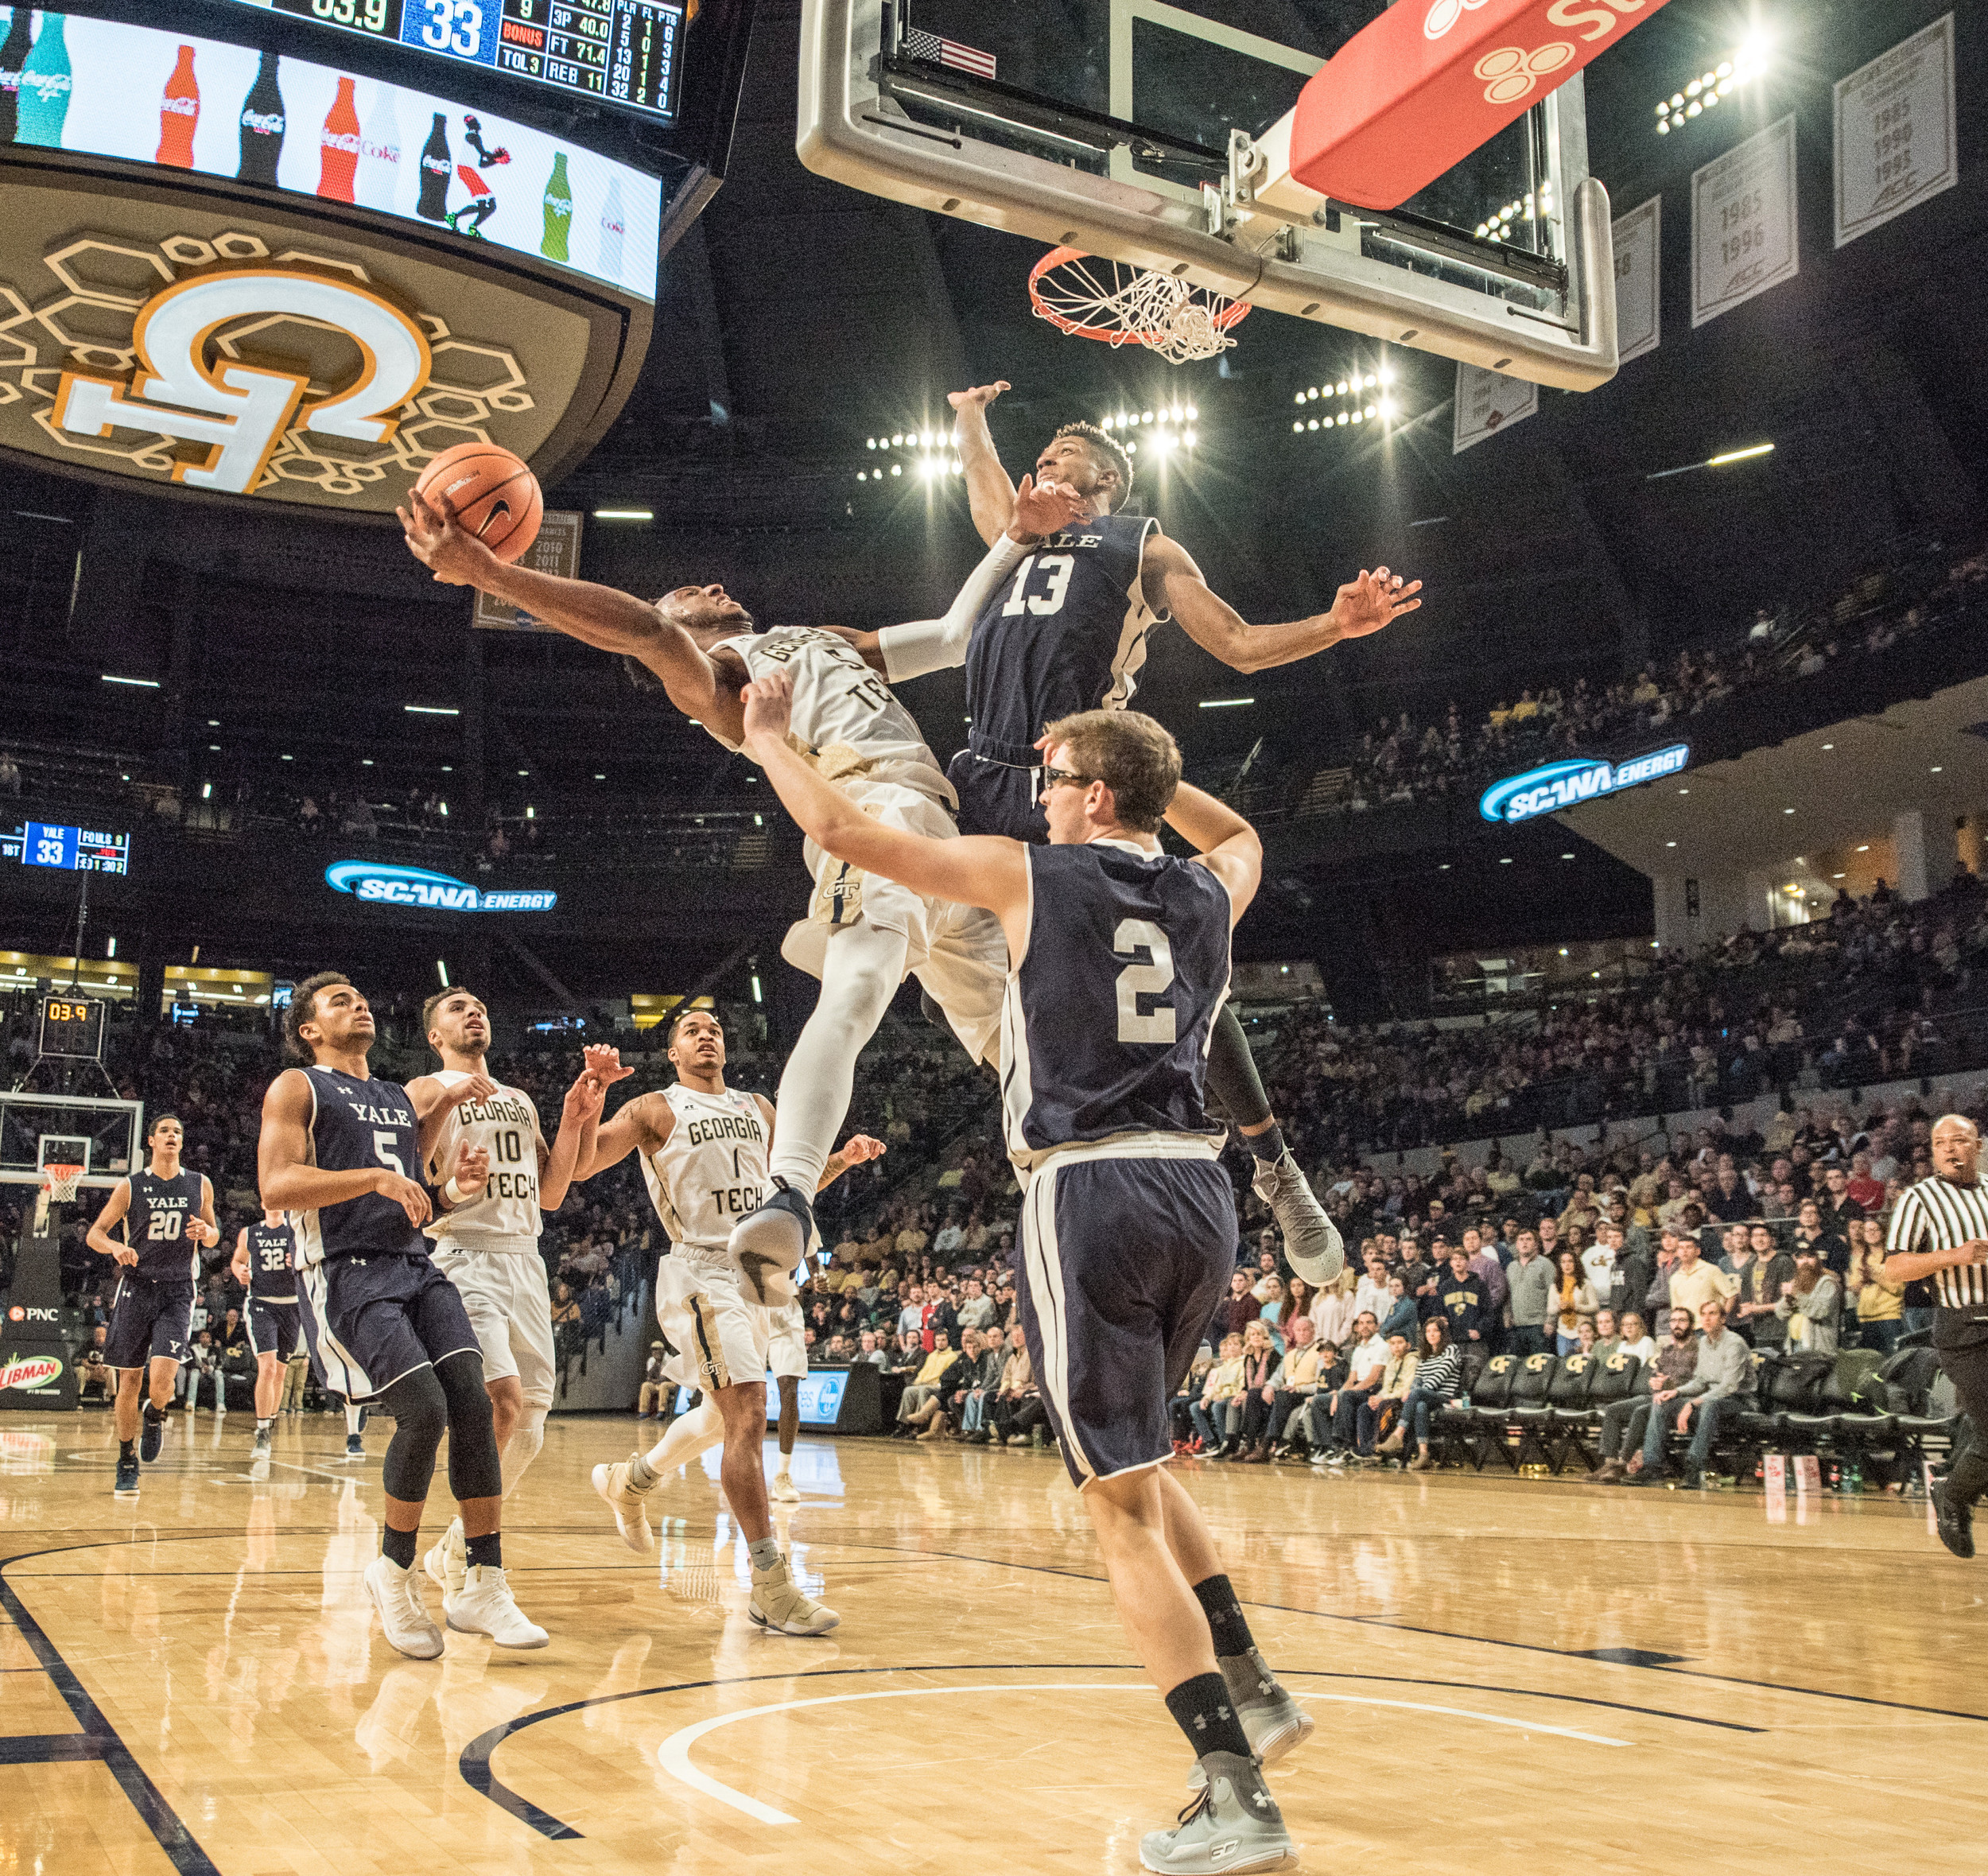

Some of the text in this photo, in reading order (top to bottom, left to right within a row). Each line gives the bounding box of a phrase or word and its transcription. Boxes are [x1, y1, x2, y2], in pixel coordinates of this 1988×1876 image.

[553, 9, 608, 39] 3P 40.0
[616, 0, 678, 26] PLR FL PTS
[422, 0, 483, 57] 33
[503, 21, 543, 47] BONUS
[621, 14, 674, 42] 2 1 6
[550, 35, 606, 65] FT 71.4
[619, 30, 672, 59] 5 0 3
[530, 56, 540, 74] 3
[616, 47, 670, 76] 13 1 3
[548, 61, 603, 91] REB 11
[612, 63, 669, 93] 20 1 4
[610, 80, 667, 110] 32 2 0
[1040, 534, 1104, 548] ALE
[1002, 553, 1075, 617] 13
[846, 671, 895, 711] TE
[1507, 748, 1688, 820] SCANA ENERGY
[43, 825, 65, 840] YALE
[82, 830, 112, 845] FOULS
[2, 843, 21, 856] 1ST
[37, 839, 64, 865] 33
[359, 879, 556, 909] SCANA ENERGY
[1114, 918, 1177, 1044] 2
[49, 1003, 87, 1021] 03.9
[348, 1102, 412, 1128] YALE
[458, 1101, 533, 1129] GEORGIA
[688, 1117, 763, 1146] GEORGIA
[373, 1129, 406, 1177] 5
[495, 1131, 522, 1162] 10
[733, 1148, 740, 1179] 1
[486, 1172, 537, 1202] TECH
[711, 1186, 763, 1214] TECH
[146, 1197, 188, 1209] YALE
[147, 1210, 183, 1241] 20
[257, 1237, 288, 1248] YALE
[259, 1247, 285, 1271] 32
[26, 1307, 59, 1321] PNC
[169, 1340, 181, 1354] Y
[0, 1362, 56, 1387] LIBMAN
[701, 1360, 722, 1376] GT
